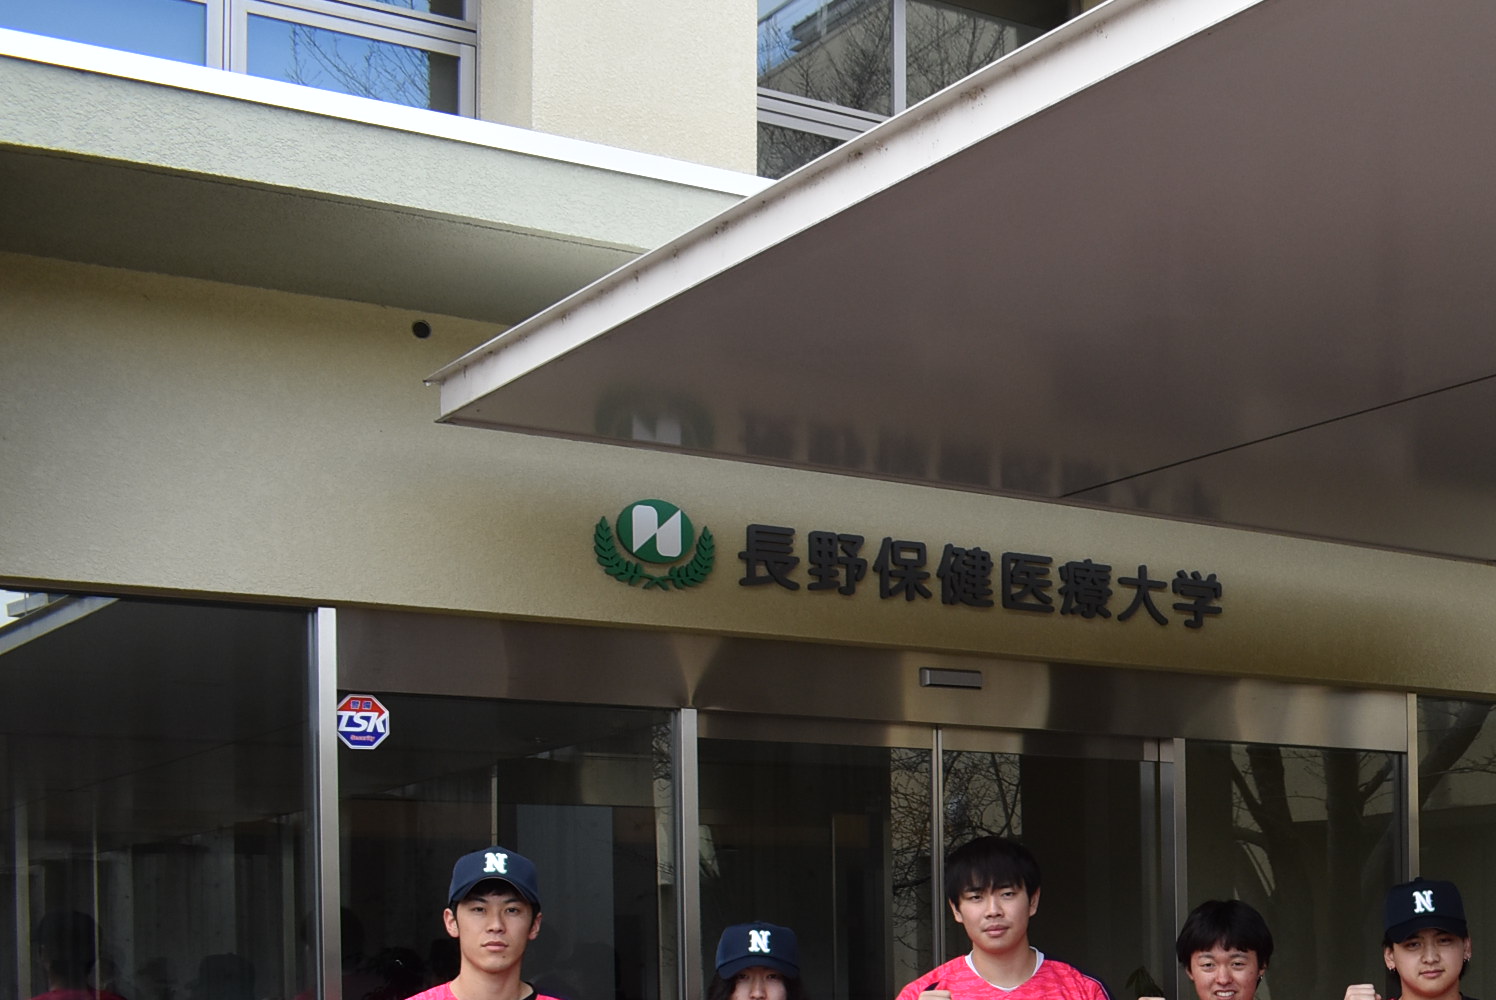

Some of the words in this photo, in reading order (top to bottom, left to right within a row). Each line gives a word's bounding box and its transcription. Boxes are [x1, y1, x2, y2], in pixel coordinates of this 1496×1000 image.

[738, 523, 1224, 629] 長野保健医療大学
[337, 711, 387, 733] TSK
[482, 852, 509, 874] N
[1412, 889, 1435, 913] N
[748, 929, 771, 953] N
